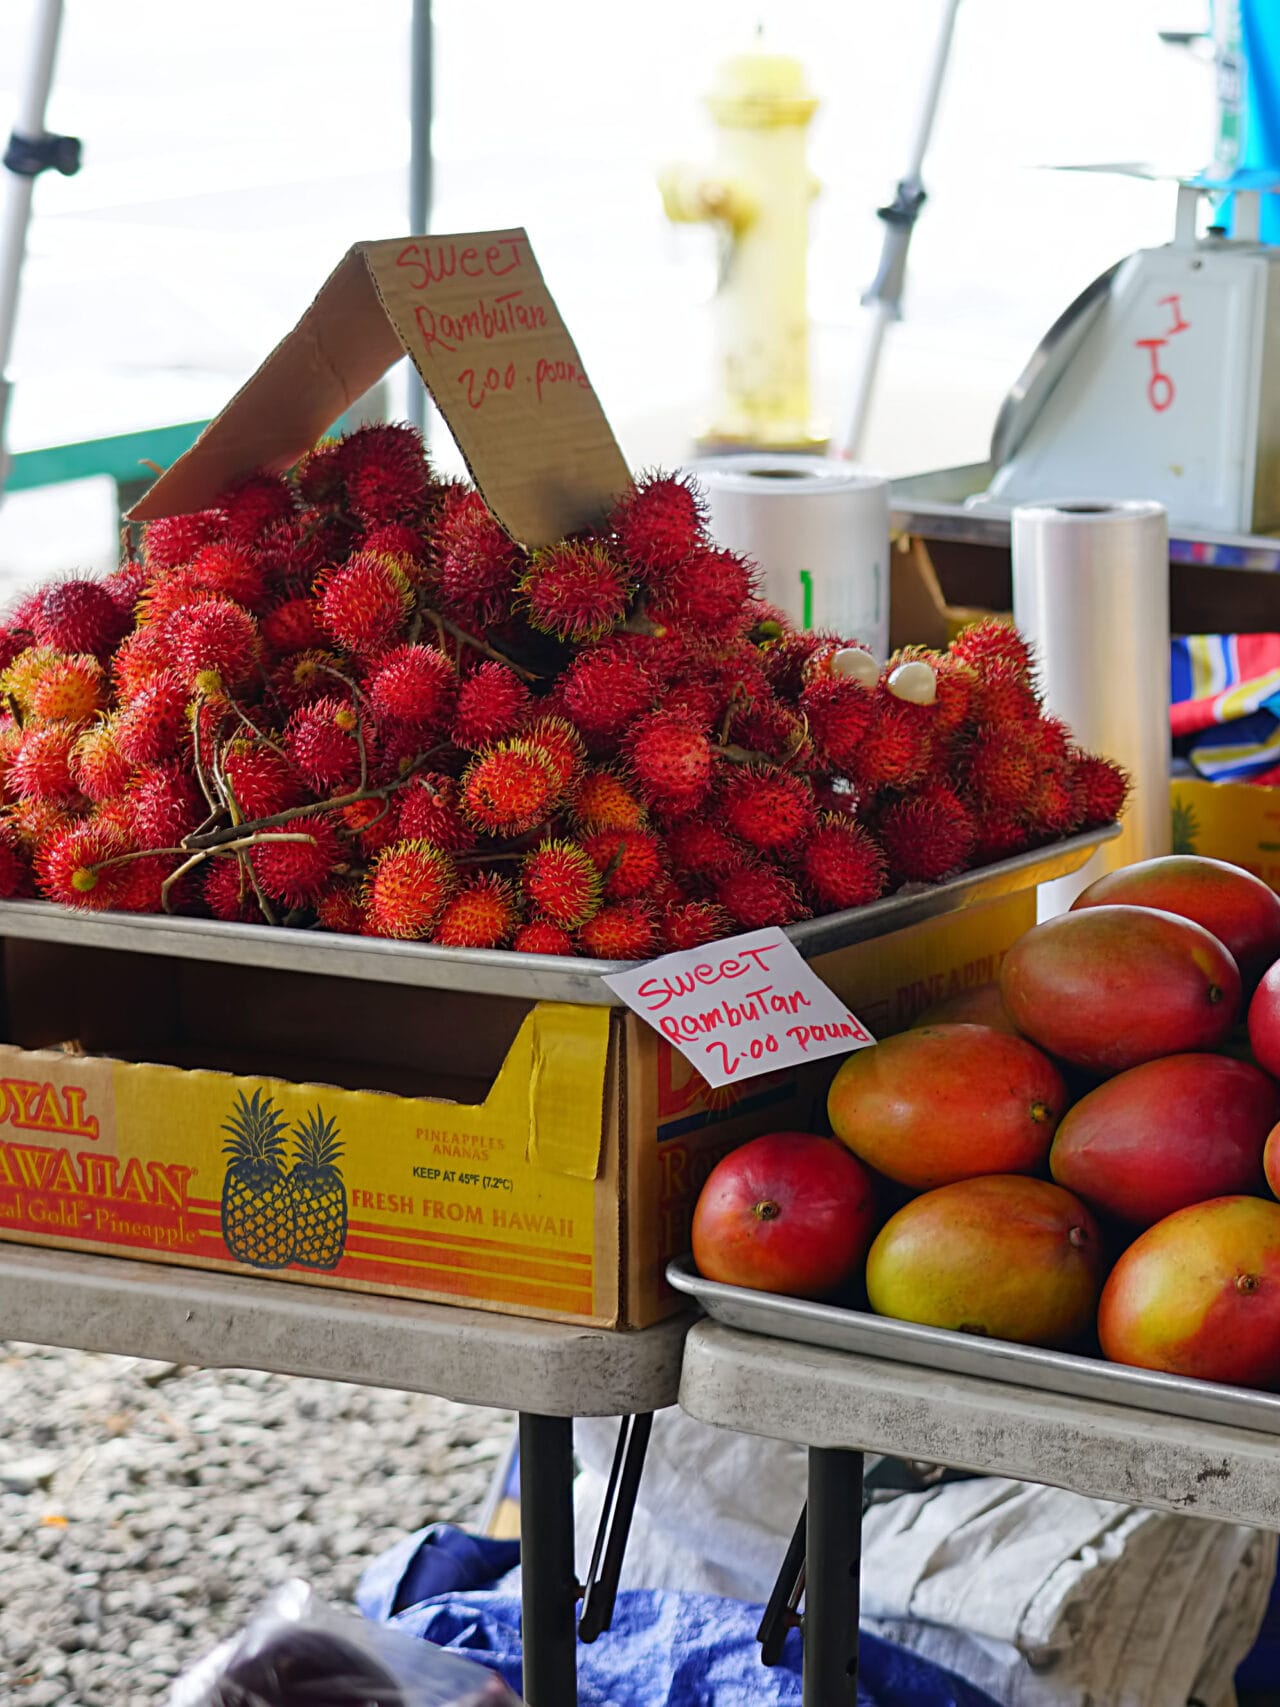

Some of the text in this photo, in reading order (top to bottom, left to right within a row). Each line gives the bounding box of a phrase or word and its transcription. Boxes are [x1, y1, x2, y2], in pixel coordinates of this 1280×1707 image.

[0, 1078, 100, 1140] YAL
[415, 1128, 505, 1150] PINEAPPLES
[432, 1143, 490, 1162] ANANAS
[412, 1167, 441, 1180] KEEP
[443, 1170, 456, 1182] AT
[95, 1208, 197, 1246] Pineapple
[352, 1189, 574, 1238] FRESH FROM HAWAII
